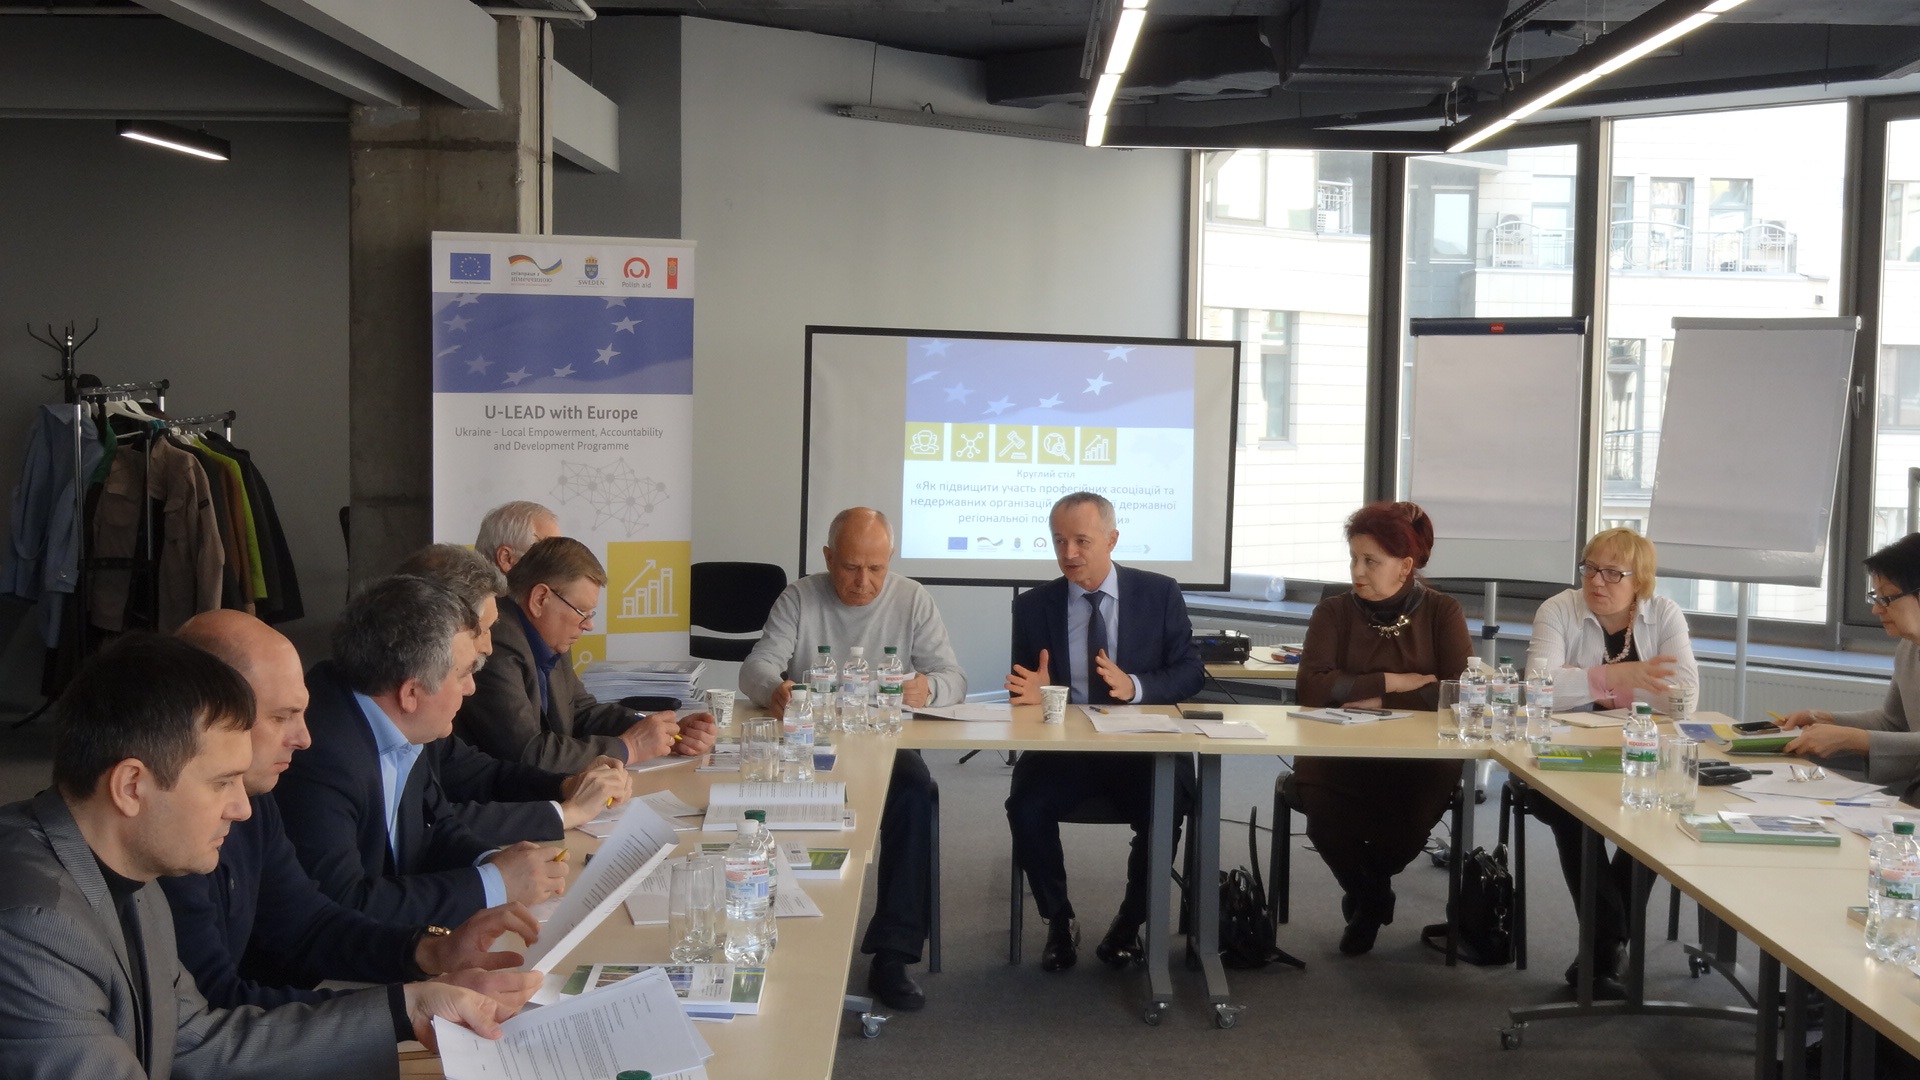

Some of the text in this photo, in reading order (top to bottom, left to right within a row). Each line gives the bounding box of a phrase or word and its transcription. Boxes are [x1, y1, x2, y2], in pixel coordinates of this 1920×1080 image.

[485, 405, 639, 423] U-LEAD with Europe
[455, 427, 492, 437] Ukraine
[501, 427, 526, 437] Local
[528, 427, 598, 439] Empowerment,
[600, 427, 664, 439] Accountability
[493, 441, 629, 453] and Development Programme
[1016, 469, 1076, 480] Круглий стіл
[939, 481, 998, 493] підвищити
[1001, 485, 1036, 494] участь
[1039, 484, 1108, 494] професійних
[1110, 484, 1161, 496] асоціацій
[910, 497, 987, 508] недержавних
[990, 498, 1052, 509] організацій
[1119, 500, 1176, 511] державної
[958, 513, 1028, 524] регіональної
